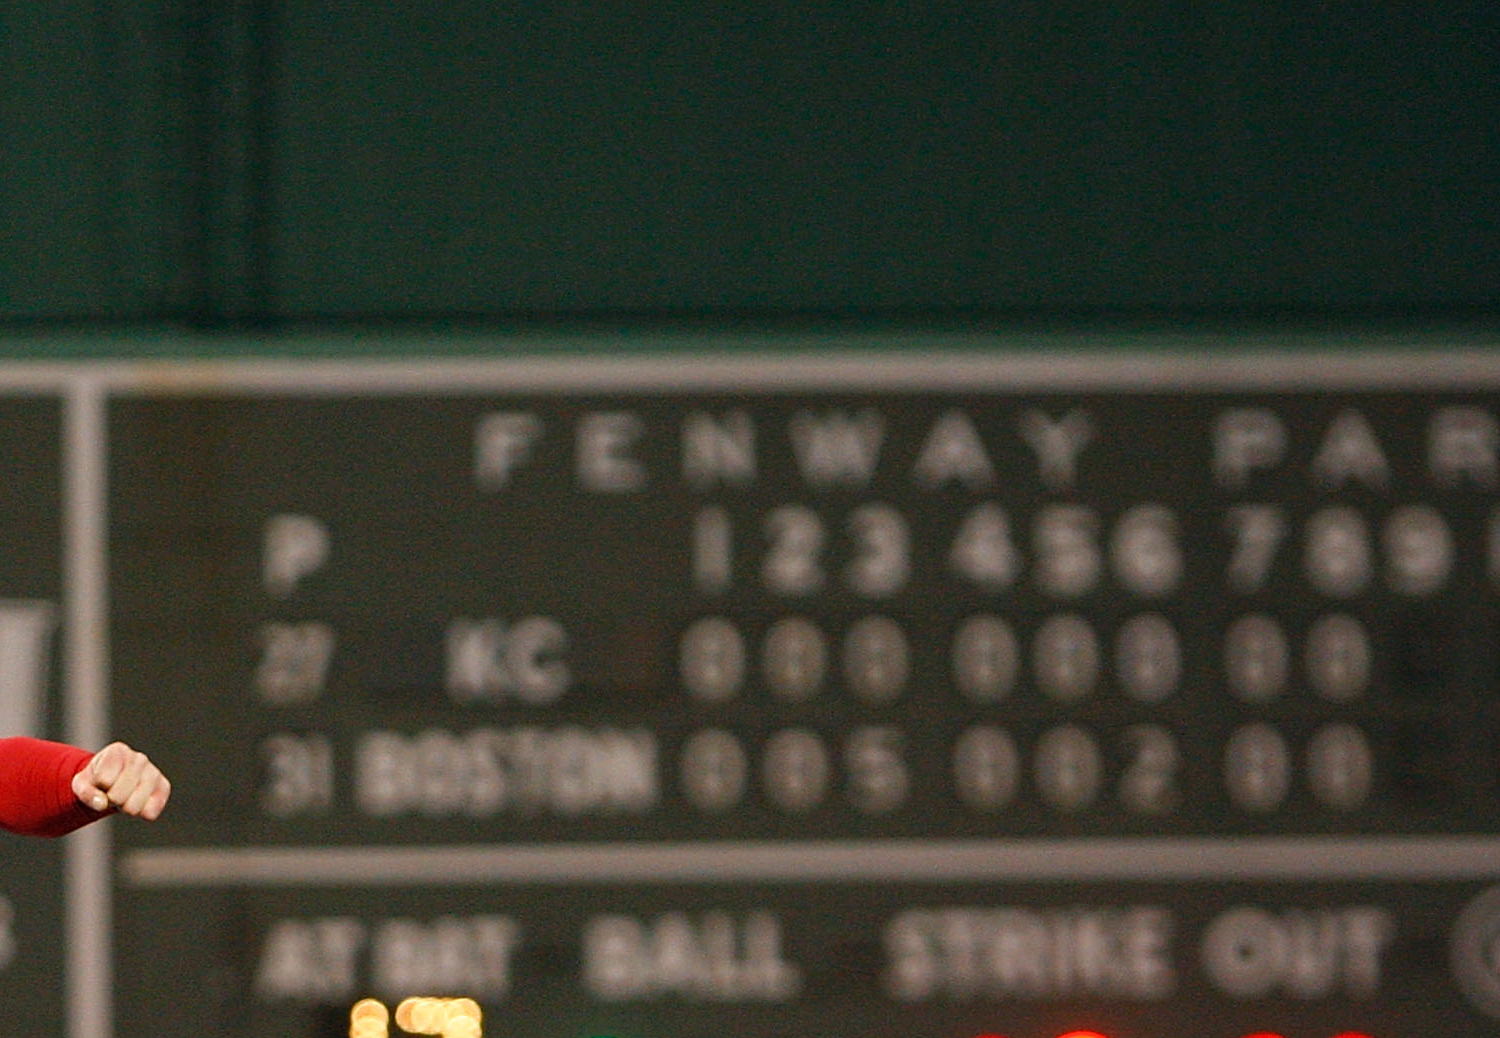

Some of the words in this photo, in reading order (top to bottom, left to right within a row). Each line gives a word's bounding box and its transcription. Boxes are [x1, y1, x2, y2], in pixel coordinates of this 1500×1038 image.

[472, 408, 1092, 494] FENWAY
[262, 513, 332, 597] P
[694, 505, 732, 596] 1
[763, 505, 826, 596] 2
[849, 505, 910, 596] 3
[952, 505, 1018, 596] 4
[1035, 505, 1100, 596] 5
[1112, 505, 1181, 596] 6
[1233, 505, 1284, 596] 7
[1308, 505, 1370, 596] 8
[1388, 505, 1451, 596] 9
[444, 614, 572, 703] KC
[680, 615, 747, 702] 0
[762, 615, 828, 702] 0
[844, 615, 910, 702] 0
[953, 615, 1019, 702] 0
[1034, 615, 1100, 702] 0
[1117, 615, 1181, 702] 0
[1227, 615, 1288, 702] 0
[1309, 615, 1371, 702] 0
[264, 732, 335, 816] 31
[353, 724, 660, 817] BOSTON
[683, 728, 748, 809] 0
[764, 728, 829, 809] 0
[846, 728, 909, 809] 5
[956, 728, 1019, 809] 0
[1038, 728, 1100, 809] 0
[1122, 728, 1178, 809] 2
[1229, 728, 1289, 809] 0
[1312, 728, 1372, 809] 0
[257, 917, 368, 1000] AT
[370, 915, 518, 1002] BAT
[583, 911, 799, 1001] BALL
[885, 907, 1172, 1000] STRIKE
[1204, 907, 1392, 995] OUT
